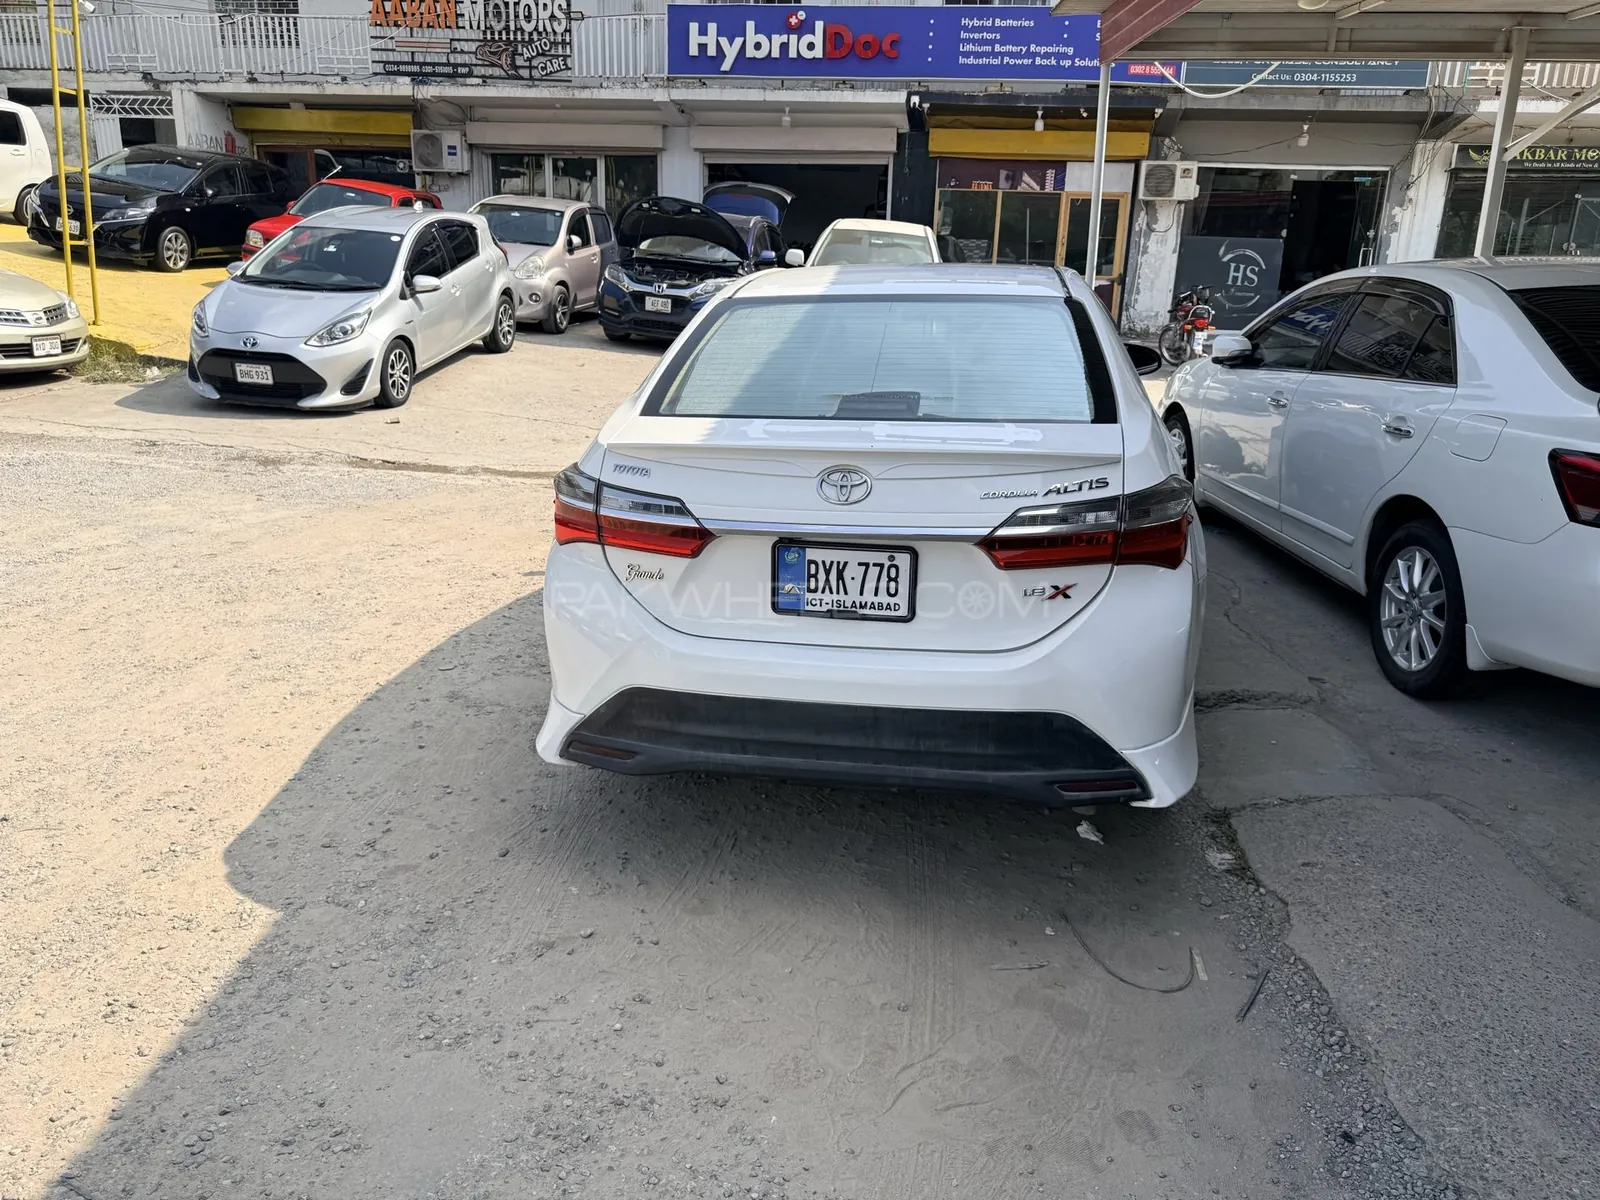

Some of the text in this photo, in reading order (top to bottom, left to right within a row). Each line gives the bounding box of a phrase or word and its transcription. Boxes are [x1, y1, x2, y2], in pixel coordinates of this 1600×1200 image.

[370, 0, 567, 34] AABAN MOTORS
[961, 17, 1035, 29] Hybrid Batteries
[960, 30, 1001, 40] Invertors
[522, 37, 550, 60] AUTO
[689, 20, 901, 71] HybridDoc
[959, 43, 1074, 55] Lithium Battery Repairing
[538, 57, 566, 76] CARE
[958, 55, 1002, 66] Industrial
[1003, 57, 1033, 66] Power
[1035, 57, 1058, 67] Back
[1059, 60, 1072, 69] up
[1251, 73, 1357, 82] Contact Us: 0304-1155253
[1226, 263, 1260, 287] HS
[239, 369, 270, 381] BHG 931
[613, 463, 652, 478] TOYOTA
[980, 477, 1109, 500] COROLLA ALTIS
[624, 562, 665, 584] Grande
[806, 597, 901, 612] ICT-ISLAMABAD
